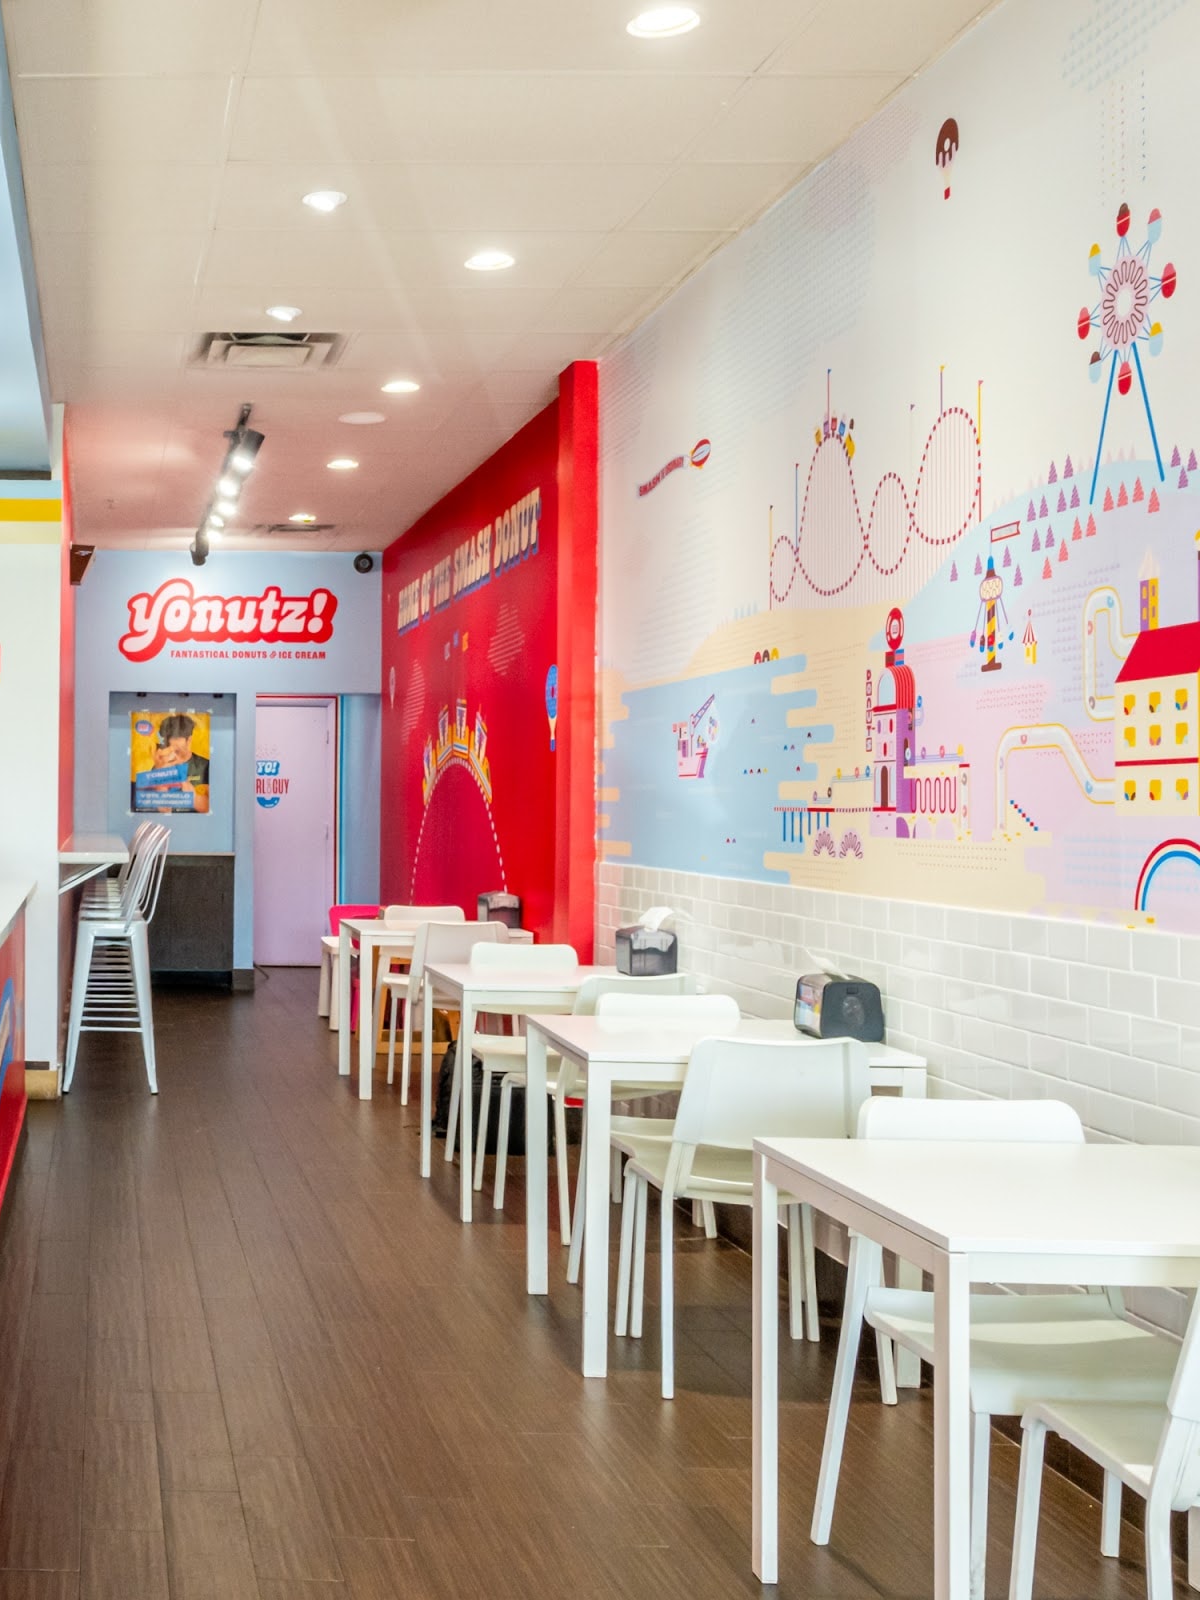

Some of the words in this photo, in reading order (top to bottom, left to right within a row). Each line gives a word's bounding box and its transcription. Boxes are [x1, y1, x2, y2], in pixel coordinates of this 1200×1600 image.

[453, 524, 492, 602] SMASH
[493, 486, 541, 577] DONUT
[170, 650, 229, 659] FANTASTICAL
[231, 650, 267, 659] DONUTS
[278, 650, 292, 659] ICE
[295, 650, 326, 659] CREAM
[256, 760, 280, 776] YO!
[272, 778, 289, 794] GUY
